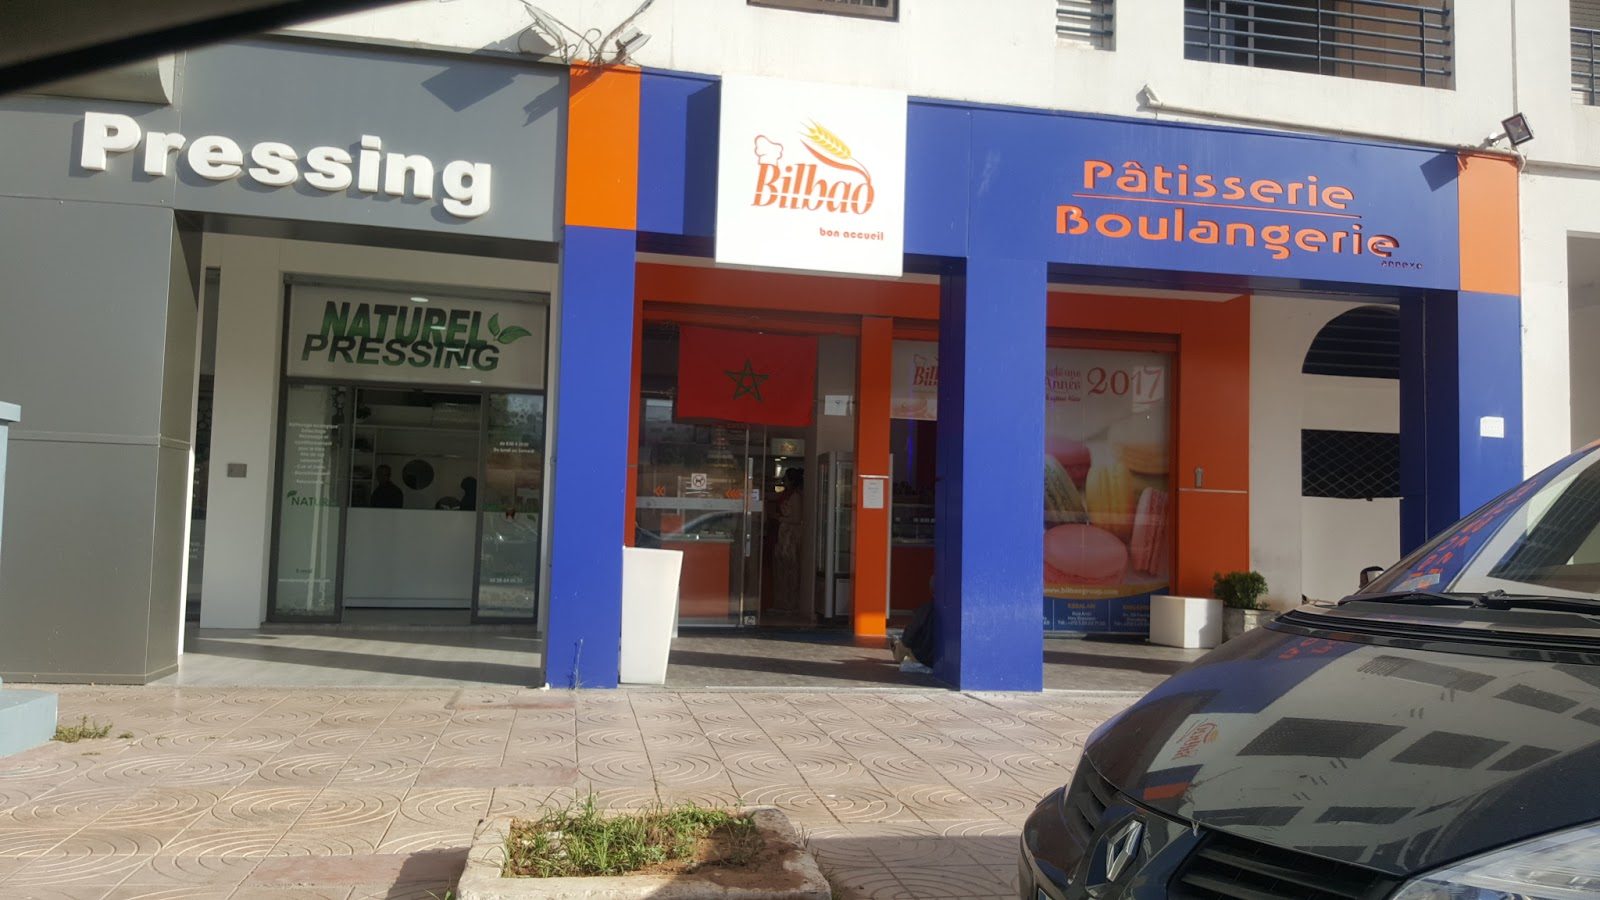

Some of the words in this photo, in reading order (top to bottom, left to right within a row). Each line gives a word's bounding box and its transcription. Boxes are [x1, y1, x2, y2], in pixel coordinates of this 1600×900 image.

[80, 111, 491, 218] Pressing
[751, 163, 874, 215] Bilbao
[1084, 159, 1354, 210] Pâtisserie
[819, 227, 840, 238] bon
[843, 230, 884, 241] accueil
[1055, 203, 1400, 260] Boulangerie
[320, 300, 488, 350] NATUREL
[301, 333, 500, 372] PRESSING
[1087, 365, 1162, 398] 2017
